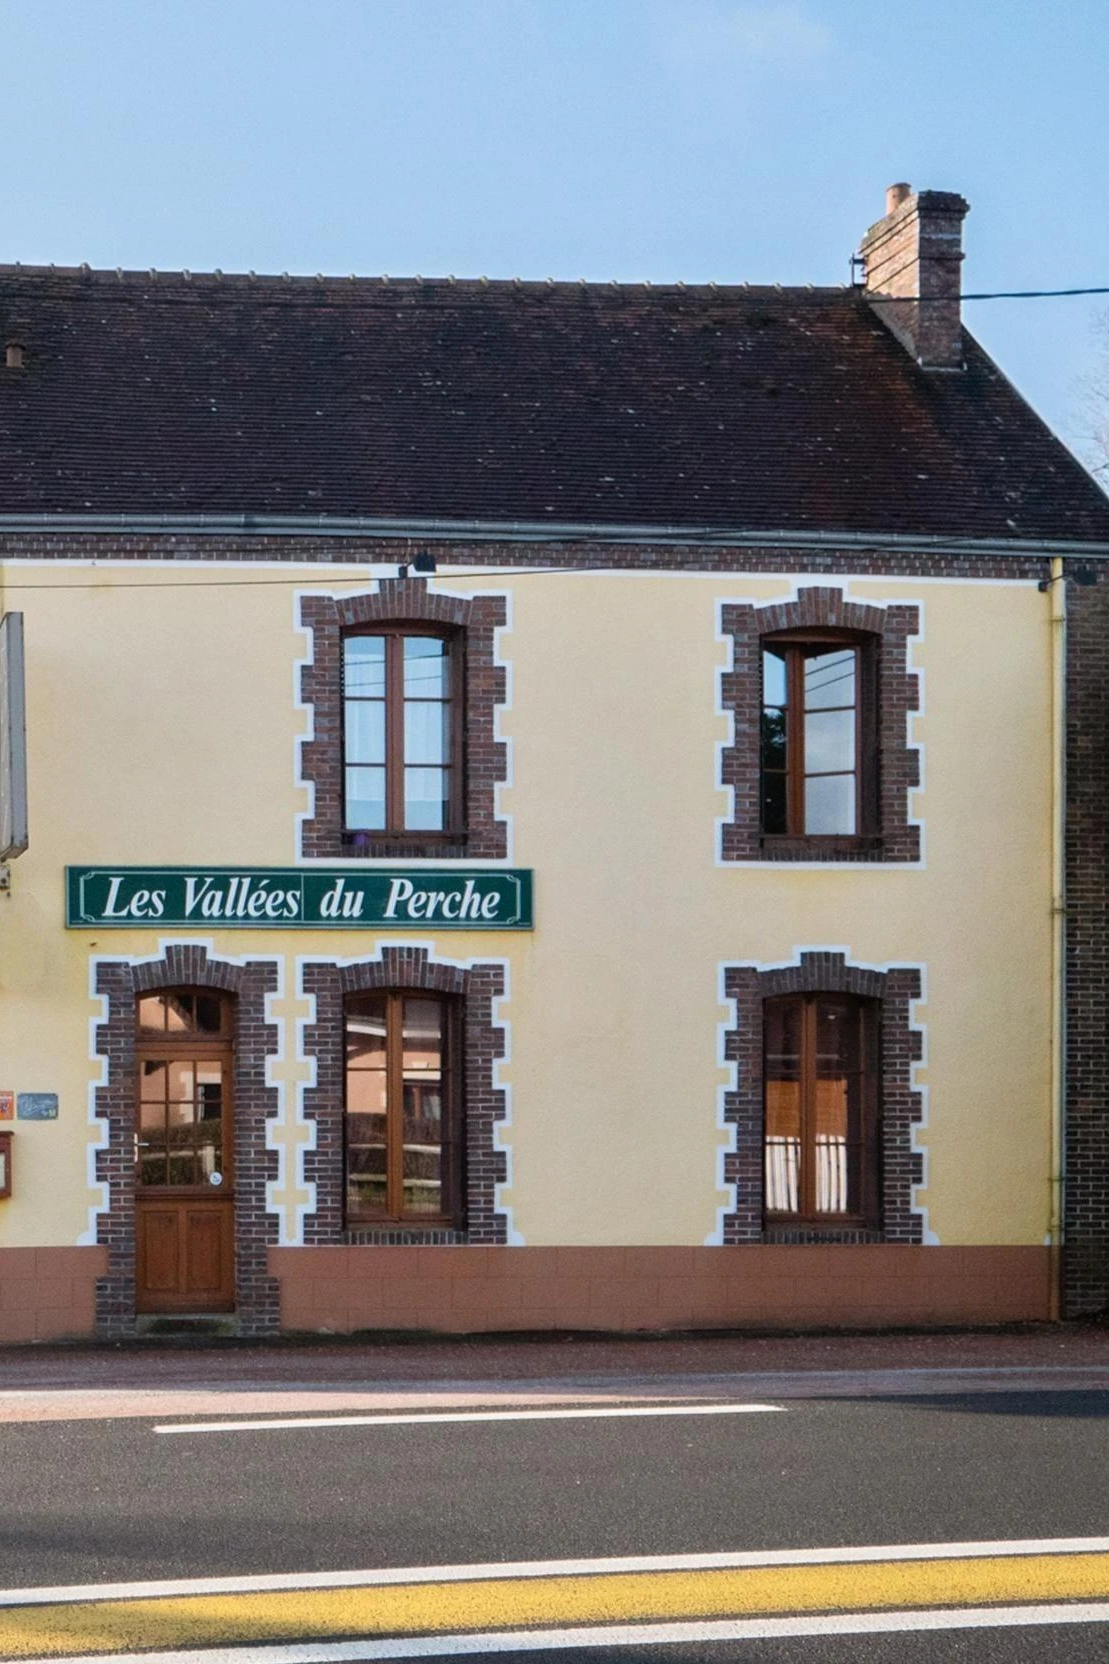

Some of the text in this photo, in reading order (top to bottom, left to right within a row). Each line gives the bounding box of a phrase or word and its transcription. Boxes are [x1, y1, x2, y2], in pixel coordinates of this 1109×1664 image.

[102, 877, 501, 919] Les Vallées du Perche
